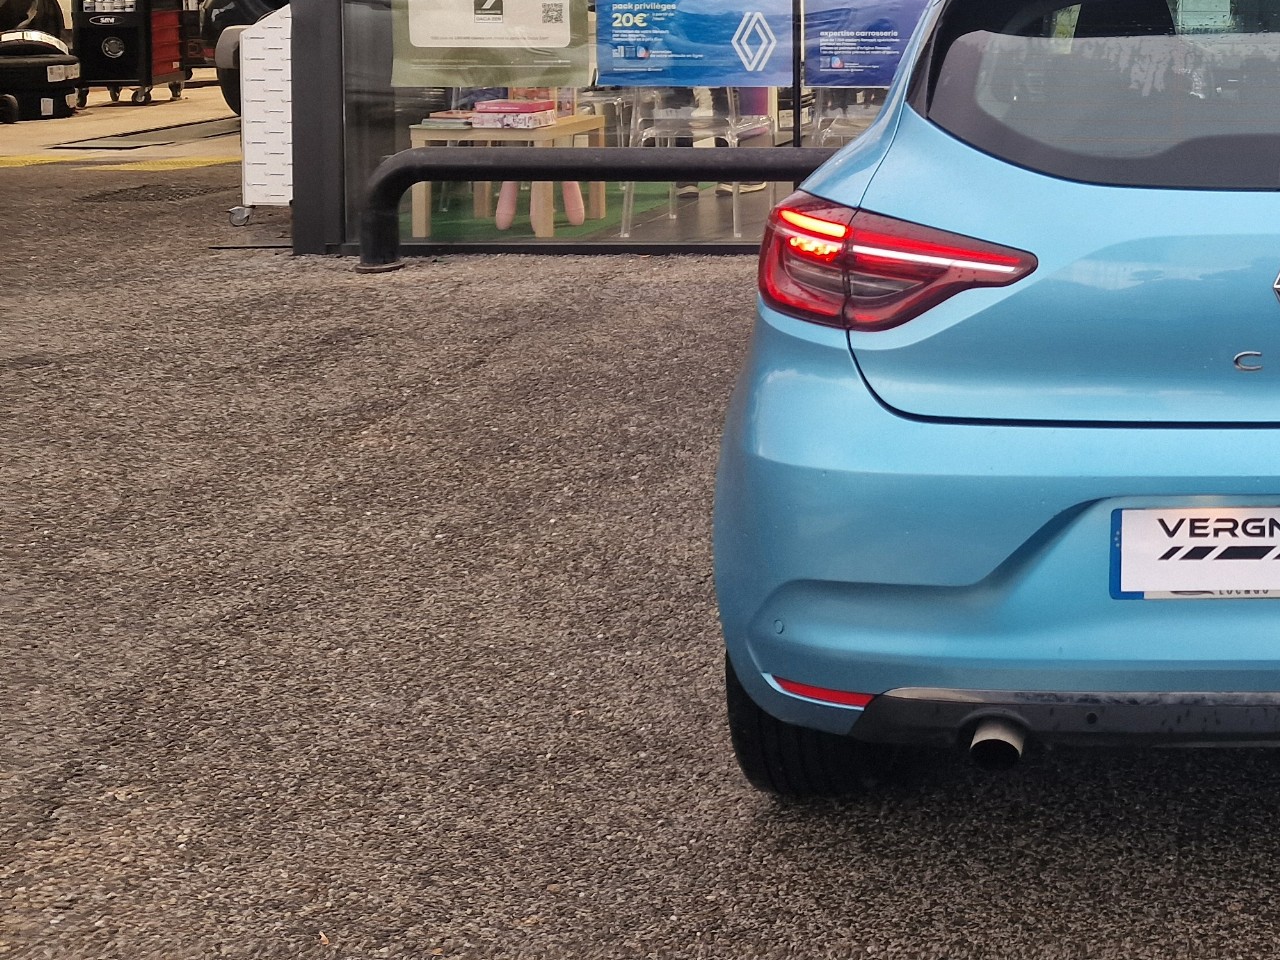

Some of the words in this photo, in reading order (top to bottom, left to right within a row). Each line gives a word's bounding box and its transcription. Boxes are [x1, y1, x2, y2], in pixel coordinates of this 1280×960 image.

[611, 3, 633, 11] pack
[634, 2, 677, 11] privilèges
[855, 29, 899, 37] carrosserie
